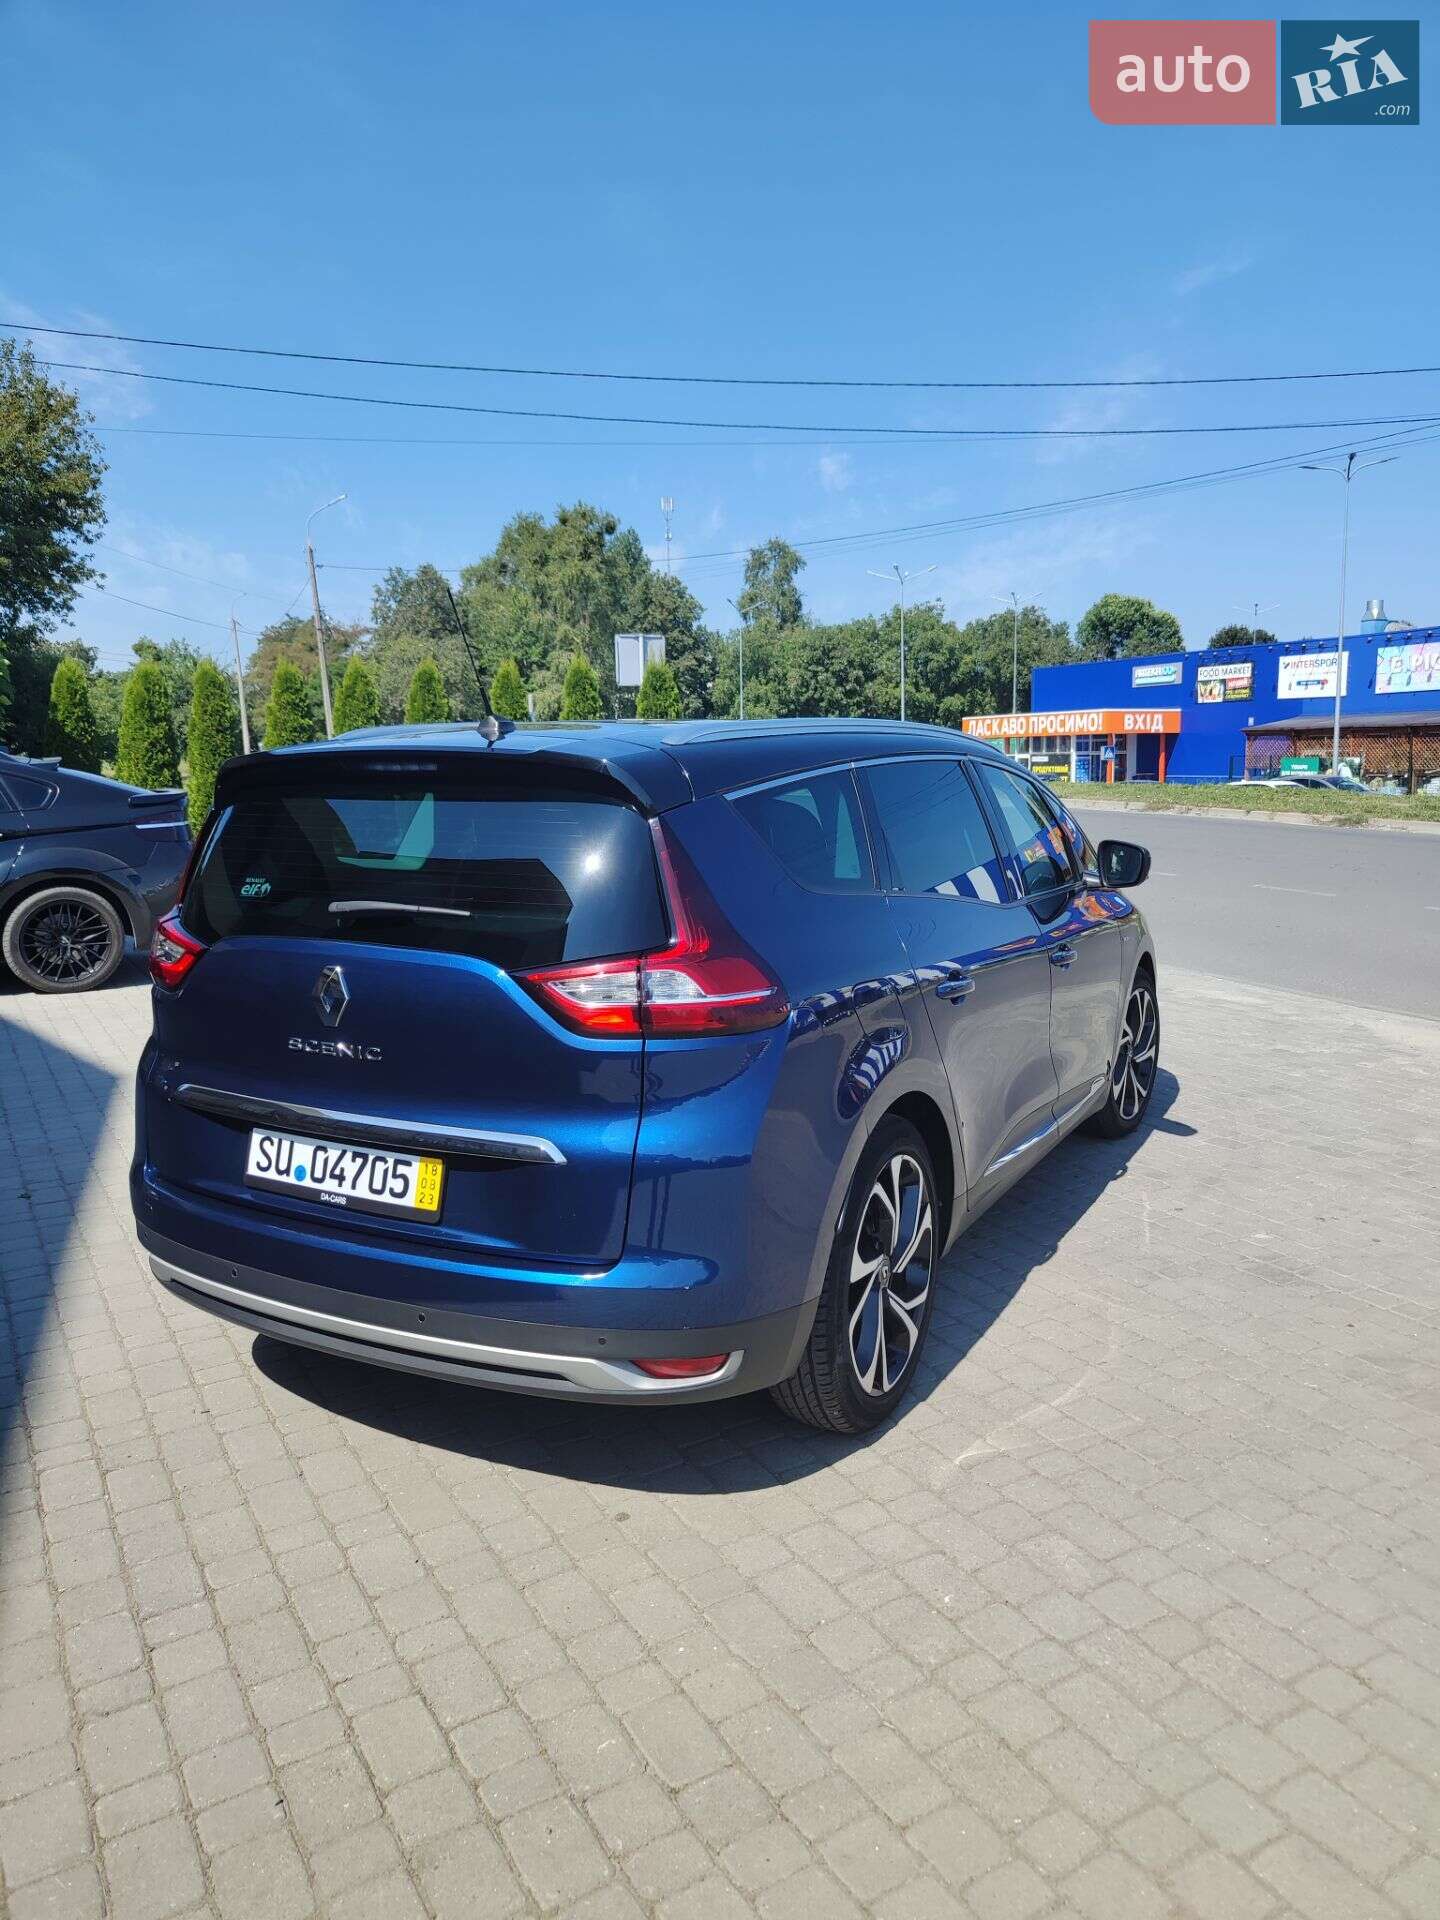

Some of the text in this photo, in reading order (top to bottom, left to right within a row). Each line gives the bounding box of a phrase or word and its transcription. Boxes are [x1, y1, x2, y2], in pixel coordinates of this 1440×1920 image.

[1199, 665, 1250, 679] FOOD MARKET
[1291, 657, 1340, 670] INTERSPOR
[968, 712, 1104, 737] ЛАСКАВО ПРОСИМО!
[1124, 712, 1164, 733] ВХІД
[288, 1037, 382, 1061] SCENIC
[256, 1135, 413, 1199] SU 04705
